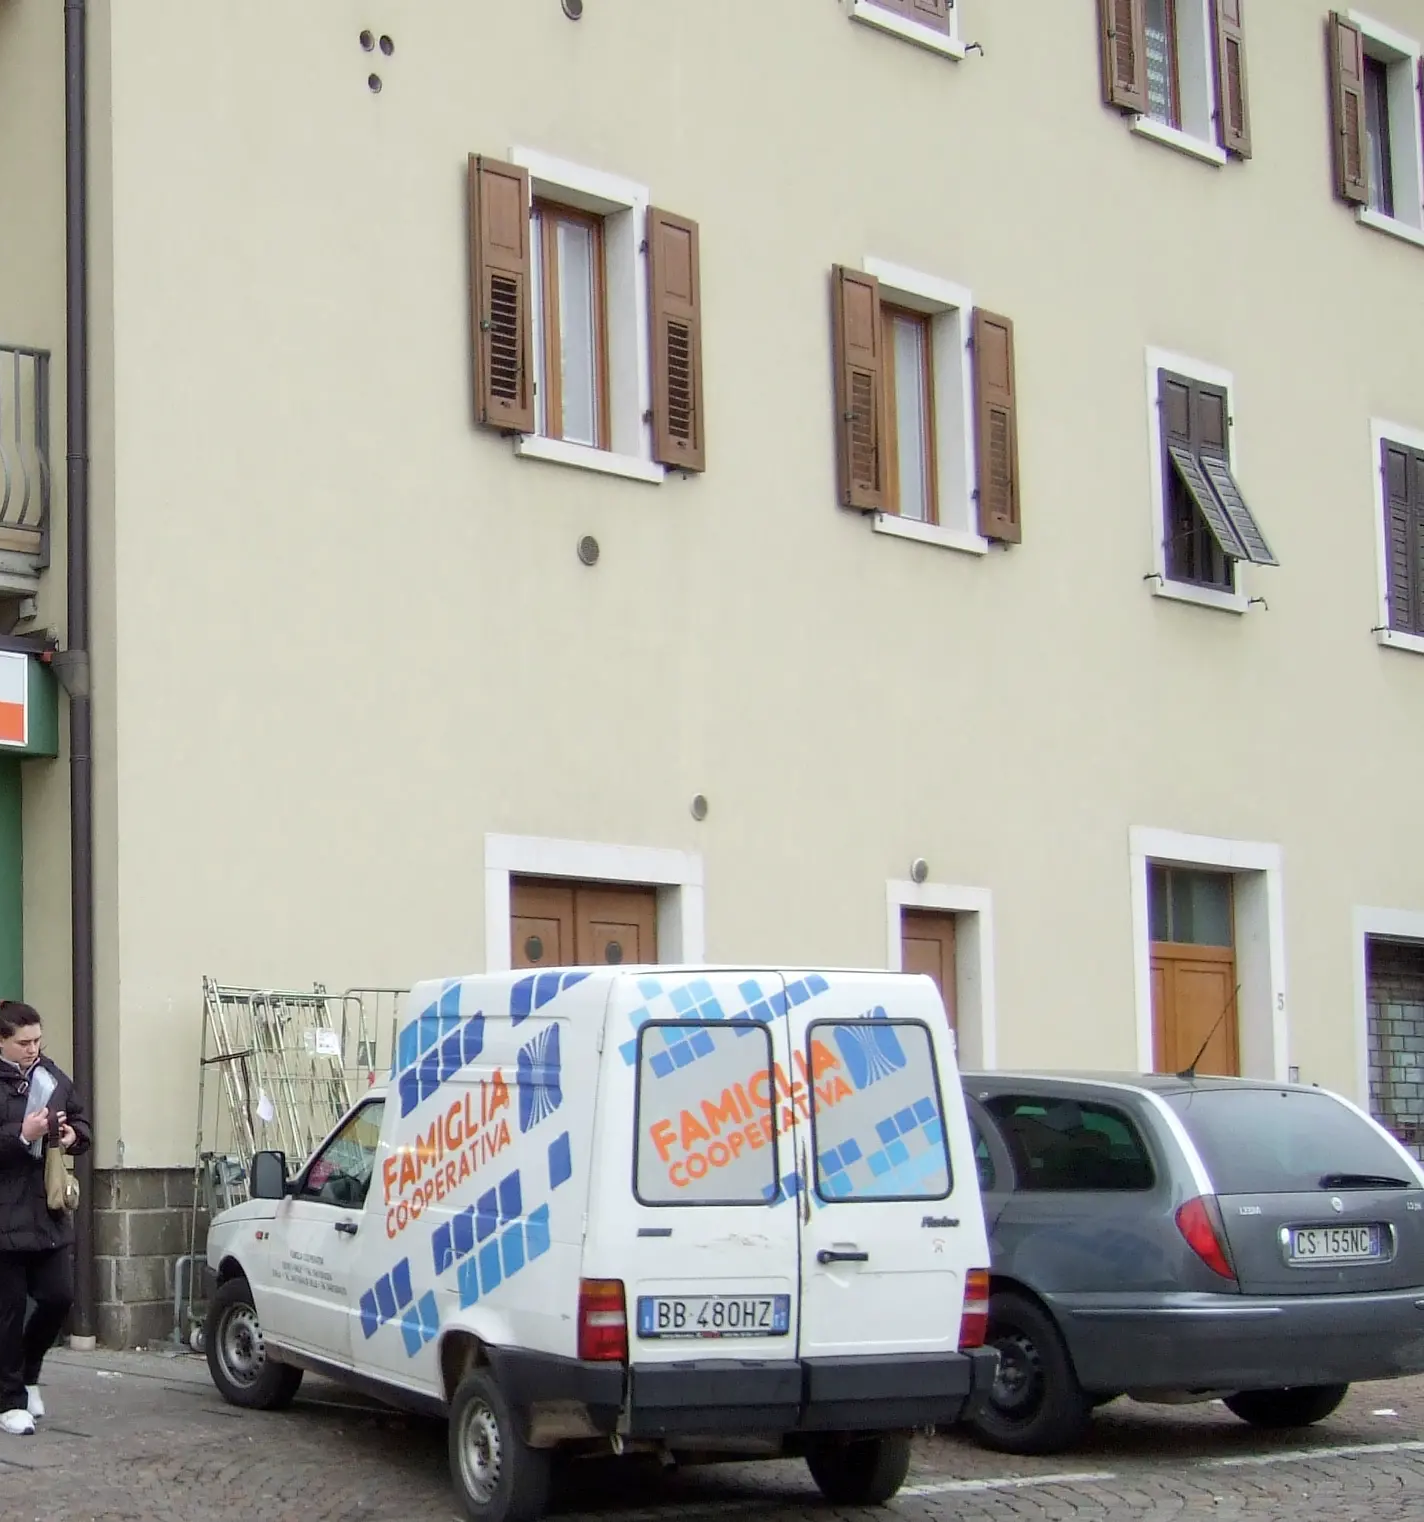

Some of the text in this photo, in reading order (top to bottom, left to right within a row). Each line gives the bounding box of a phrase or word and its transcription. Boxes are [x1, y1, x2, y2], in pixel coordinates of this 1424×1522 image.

[383, 1067, 510, 1206] FAMIGLIA
[649, 1039, 841, 1162] FAMIGLIA
[668, 1076, 854, 1187] COOPERATIVA
[386, 1118, 511, 1239] COOPERATIVA
[1297, 1230, 1369, 1254] CS 155NC
[658, 1302, 687, 1328] BB
[697, 1301, 772, 1328] 480HZ
